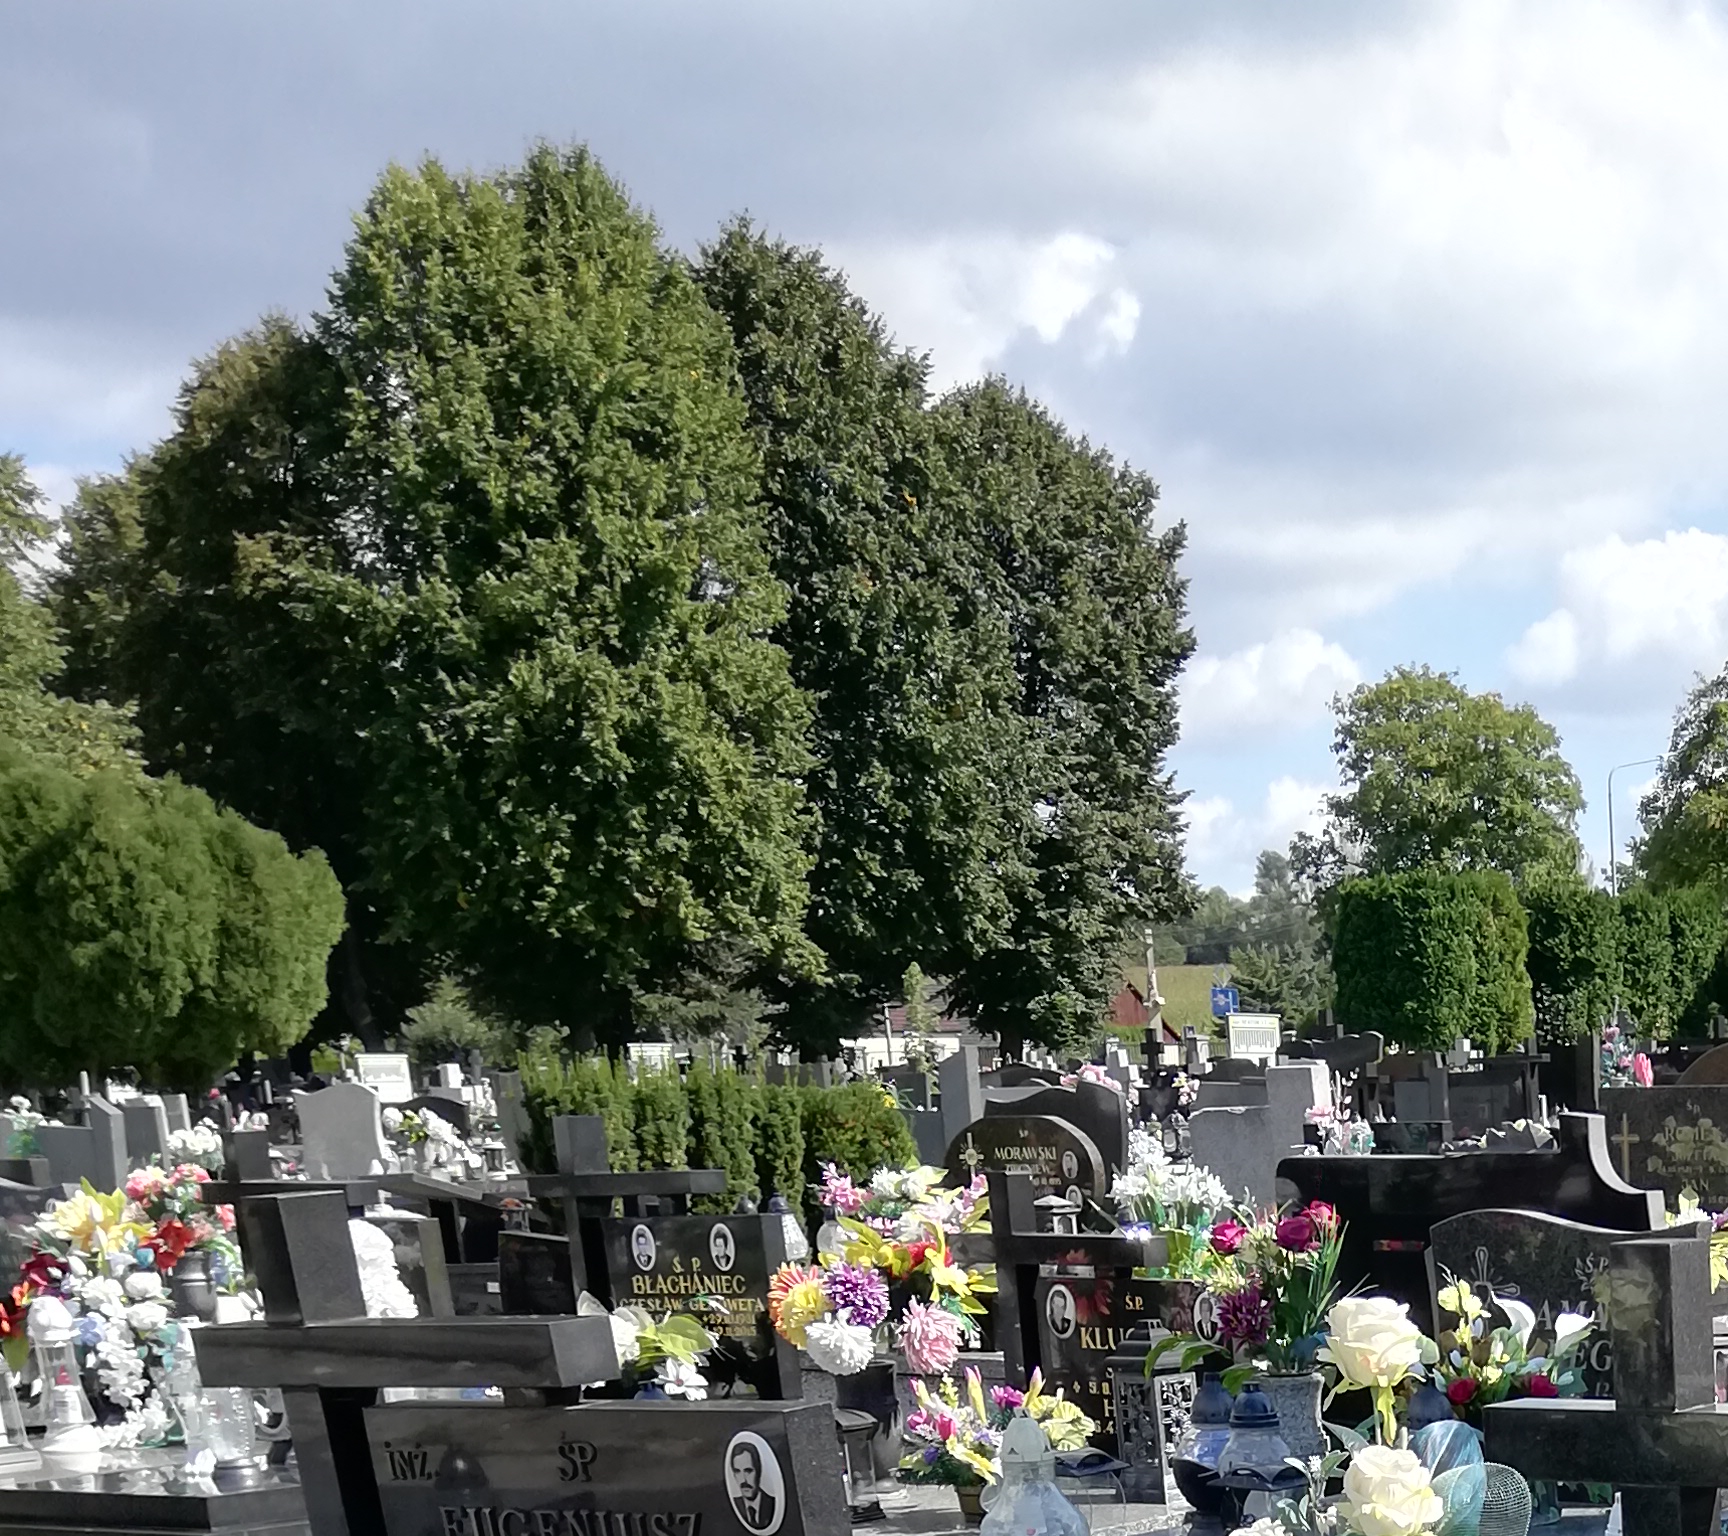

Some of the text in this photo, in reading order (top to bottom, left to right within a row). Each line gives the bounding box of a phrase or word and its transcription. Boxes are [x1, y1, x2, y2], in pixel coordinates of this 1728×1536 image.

[994, 1146, 1058, 1160] MORAWSKI
[632, 1274, 747, 1295] BŁACHANIEC
[688, 1297, 766, 1313] GEWEFA
